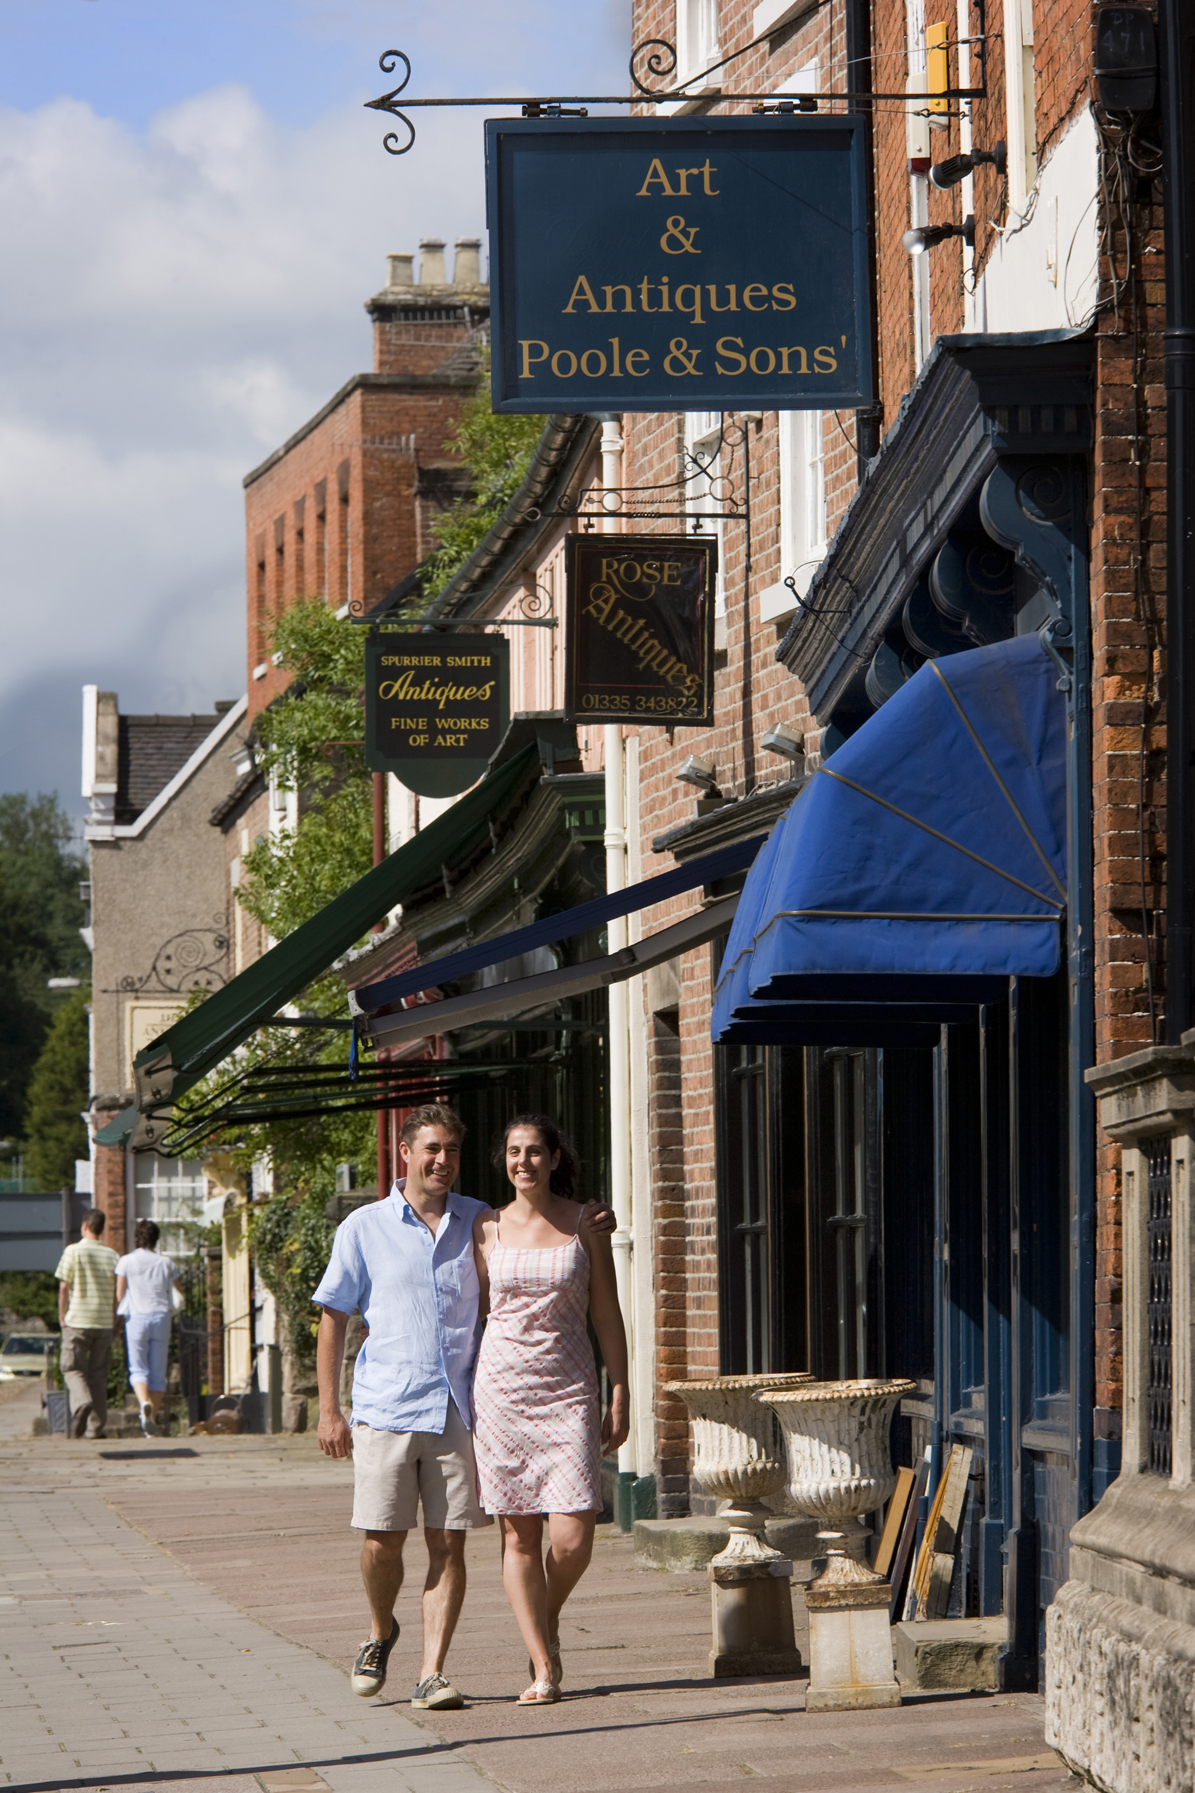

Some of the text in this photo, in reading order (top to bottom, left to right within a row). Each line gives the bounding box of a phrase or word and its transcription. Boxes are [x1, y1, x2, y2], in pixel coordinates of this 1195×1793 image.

[635, 158, 720, 196] Art
[659, 215, 702, 255] &
[562, 275, 797, 324] Antiques
[518, 335, 847, 379] Poole & Sons'
[601, 558, 682, 601] ROSE
[582, 582, 703, 696] Antiques
[381, 656, 492, 667] SPURRIER SMITH
[378, 670, 496, 710] Antiques
[582, 694, 698, 711] 01335 343822
[391, 718, 490, 730] FINE WORKS
[408, 734, 469, 747] OF ART
